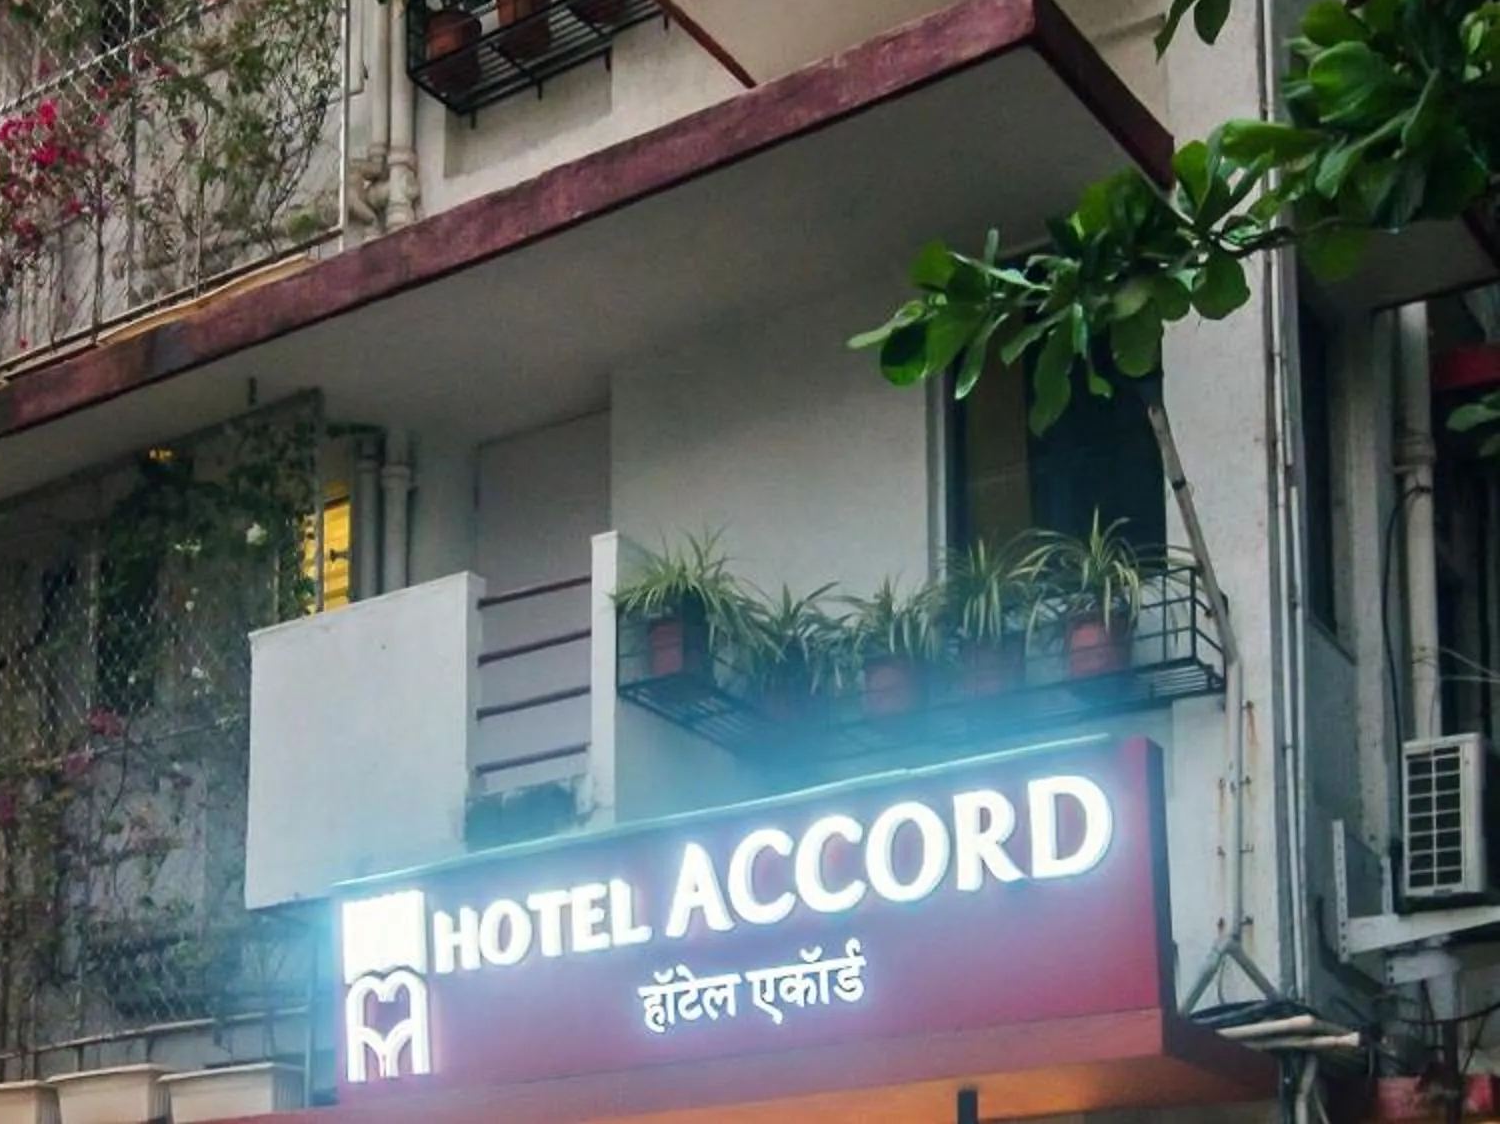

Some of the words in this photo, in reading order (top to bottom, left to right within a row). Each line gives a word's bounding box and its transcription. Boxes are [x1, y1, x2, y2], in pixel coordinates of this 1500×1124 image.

[435, 878, 652, 973] HOTEL
[665, 775, 1113, 938] ACCORD
[638, 964, 741, 1033] हॉटेल
[745, 938, 867, 1024] एकॉर्ड
